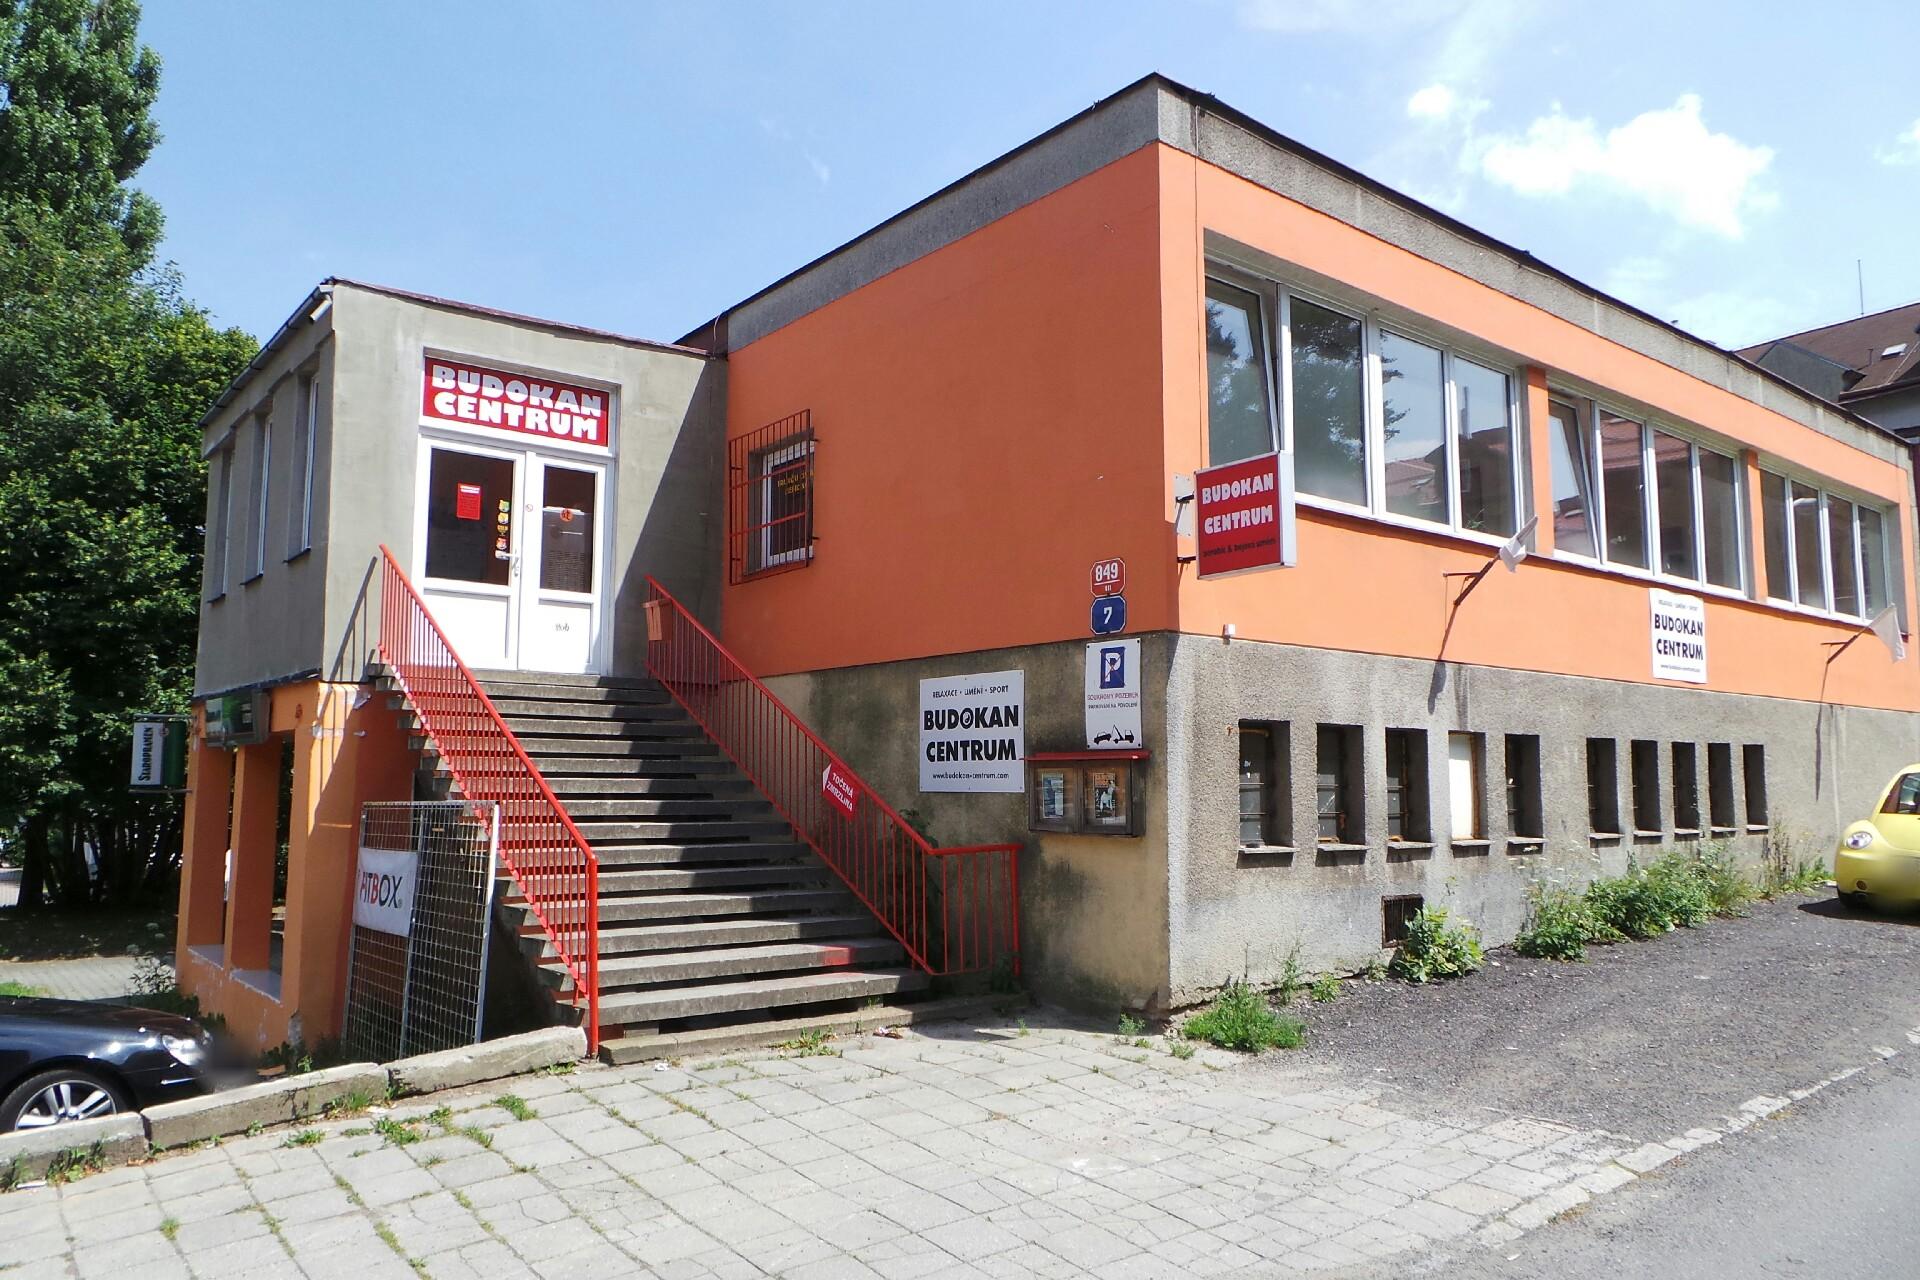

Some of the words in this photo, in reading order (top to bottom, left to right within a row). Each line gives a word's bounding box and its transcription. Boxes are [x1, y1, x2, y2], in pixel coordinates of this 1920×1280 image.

[432, 365, 601, 417] BUDOKAN
[434, 392, 597, 440] CENTRUM
[1202, 473, 1274, 505] BUDOKAN
[1205, 505, 1273, 534] CENTRUM
[1095, 562, 1119, 582] 849
[1103, 606, 1113, 625] 7
[1654, 613, 1703, 636] BUDOKAN
[1656, 638, 1703, 661] CENTRUM
[1105, 652, 1121, 682] P
[989, 685, 1009, 694] SPORT
[924, 705, 1019, 731] BUDOKAN
[926, 739, 1017, 762] CENTRUM
